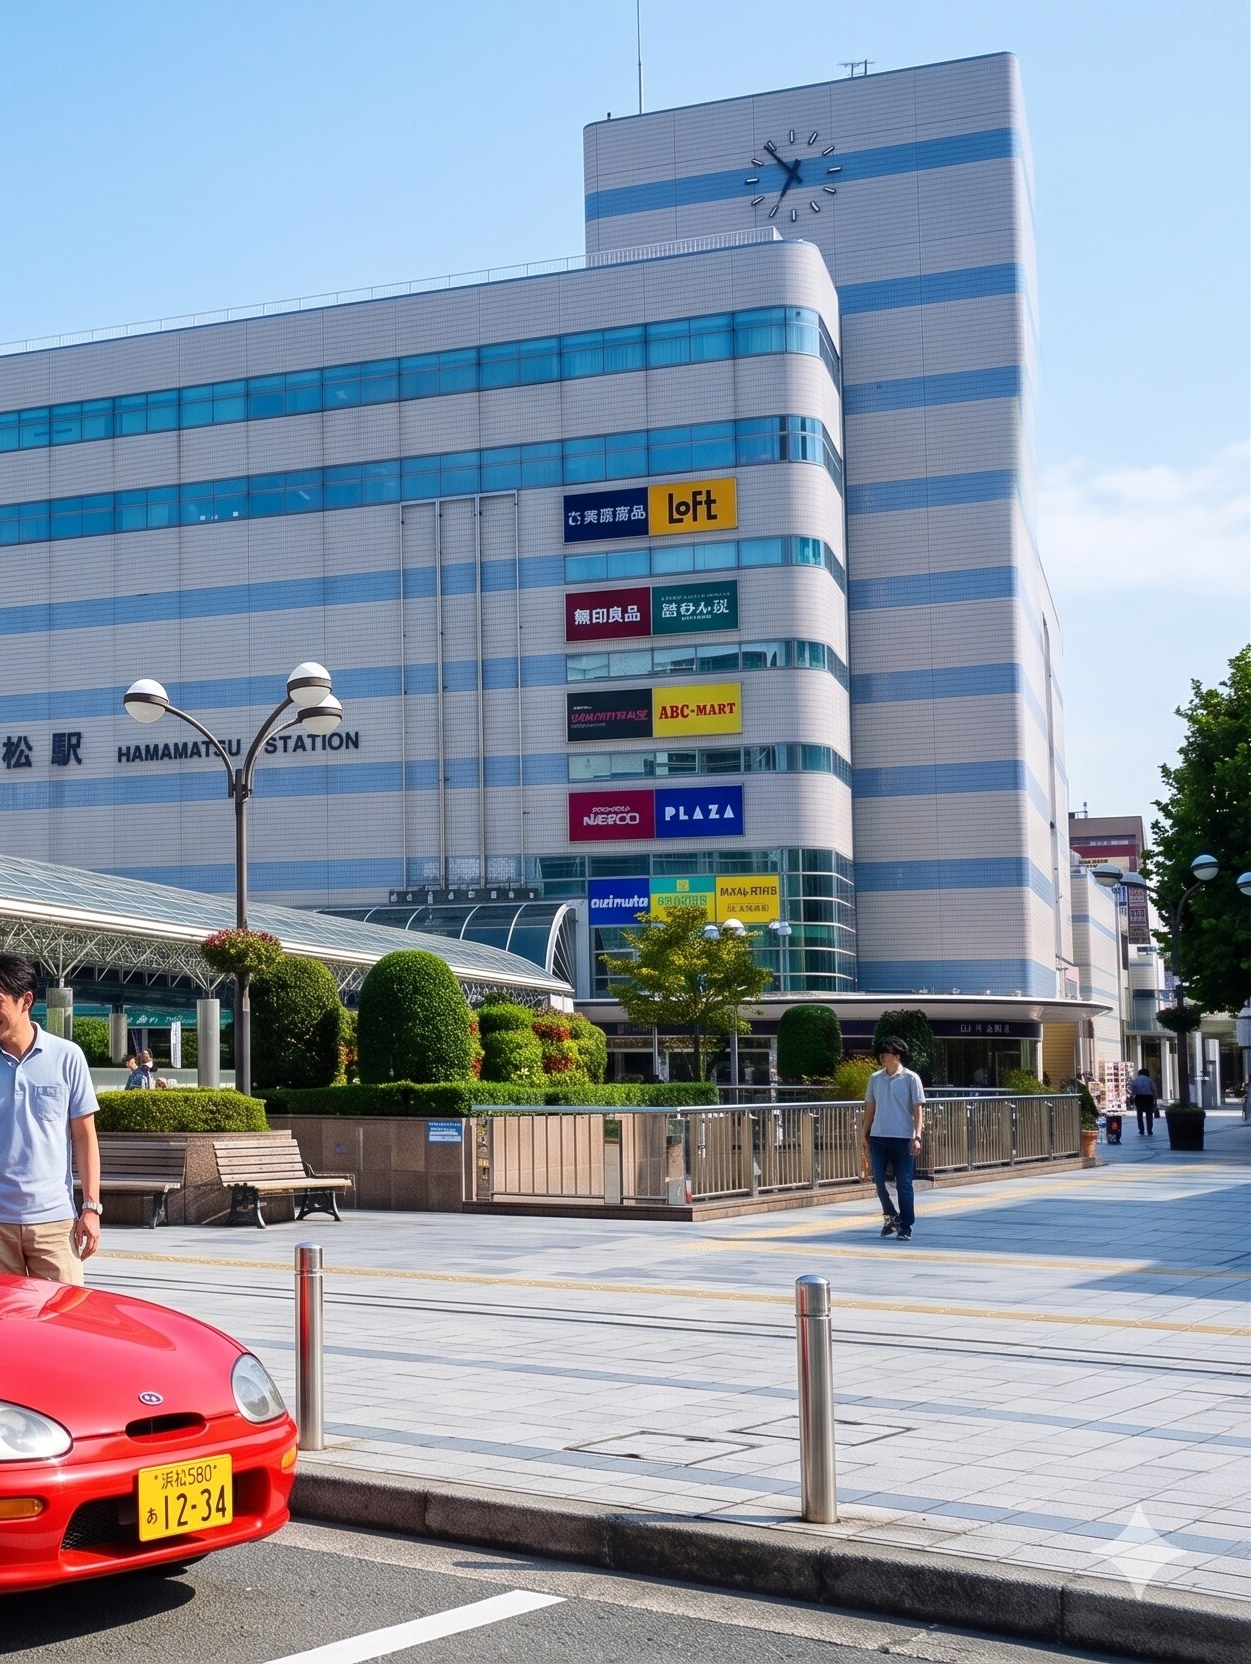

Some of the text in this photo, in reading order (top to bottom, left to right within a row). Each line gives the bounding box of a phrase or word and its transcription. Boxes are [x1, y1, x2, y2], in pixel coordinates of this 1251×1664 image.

[658, 702, 736, 720] ABC-MART
[264, 731, 359, 755] STATION
[664, 803, 735, 821] PLAZA
[146, 1484, 227, 1530] あ 12-34
